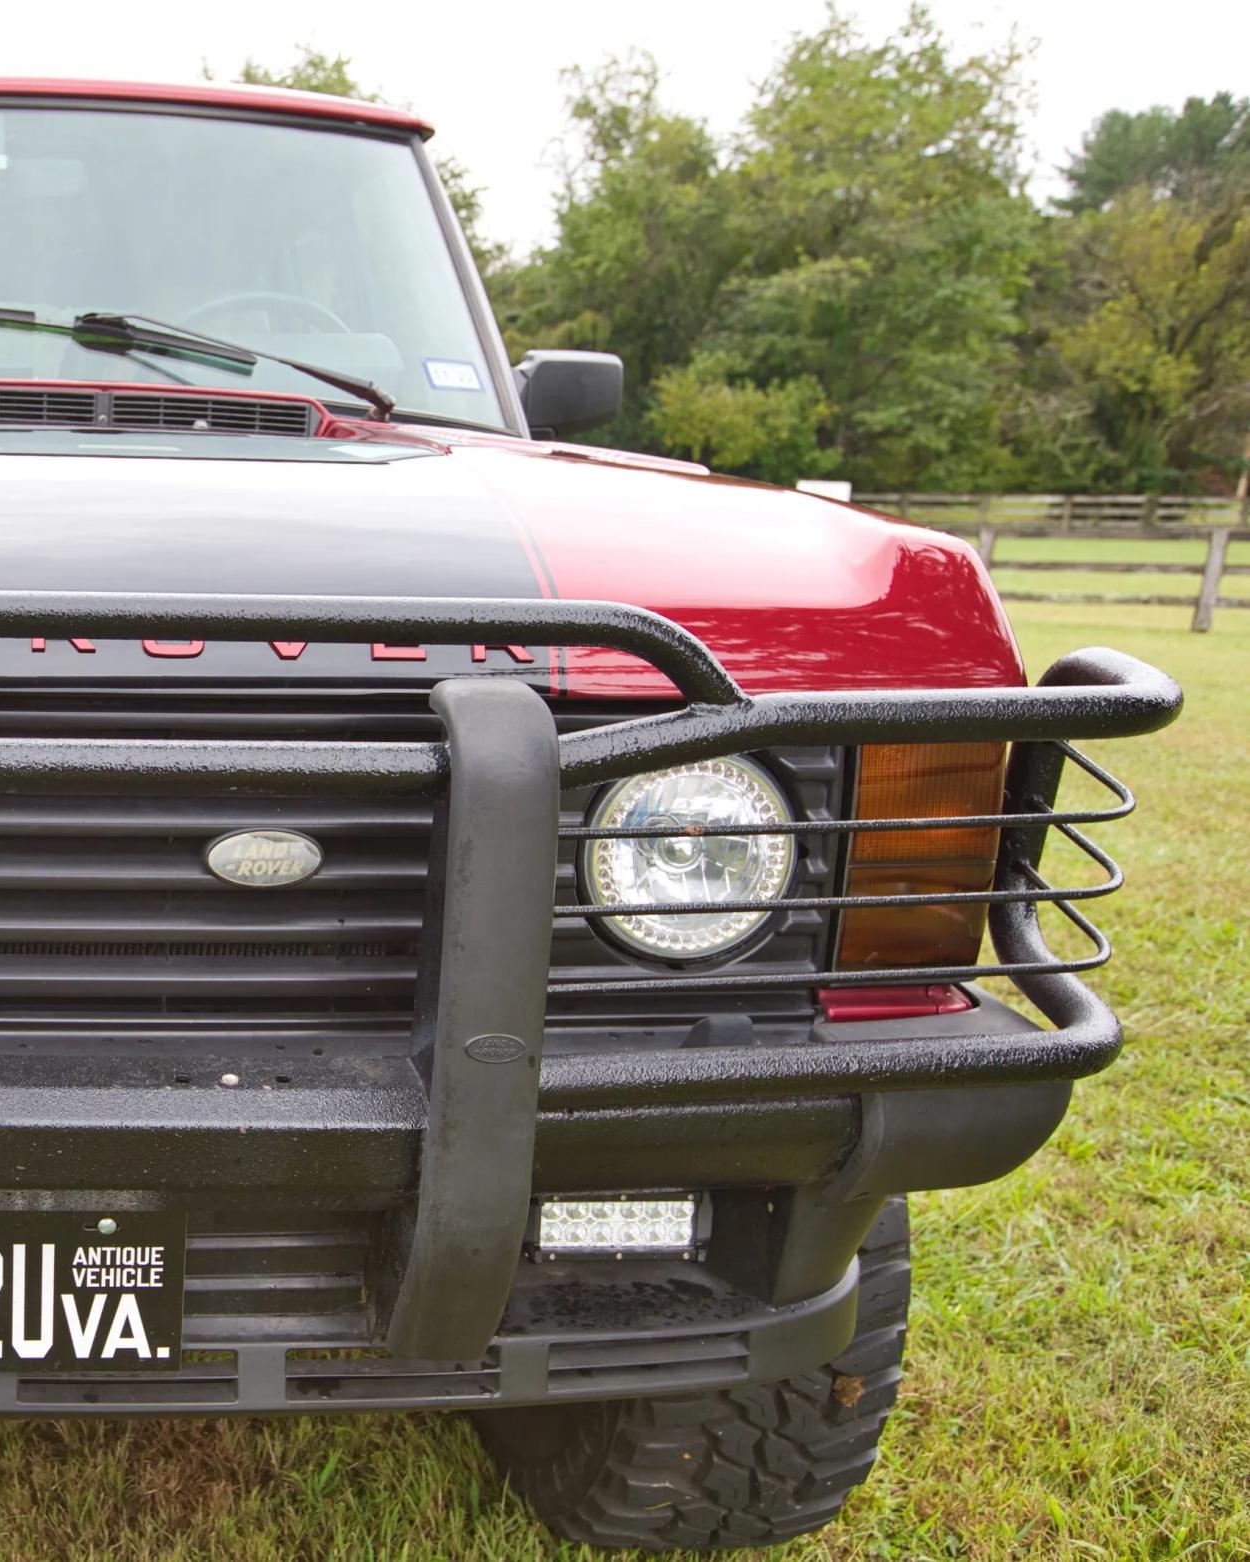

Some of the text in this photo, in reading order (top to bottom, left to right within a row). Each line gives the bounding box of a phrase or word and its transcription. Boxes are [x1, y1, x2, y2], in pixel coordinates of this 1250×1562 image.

[237, 860, 303, 877] ROVER
[72, 1246, 164, 1267] ANTIQUE
[72, 1267, 164, 1288] VEHICLE
[61, 1293, 170, 1359] VA.
